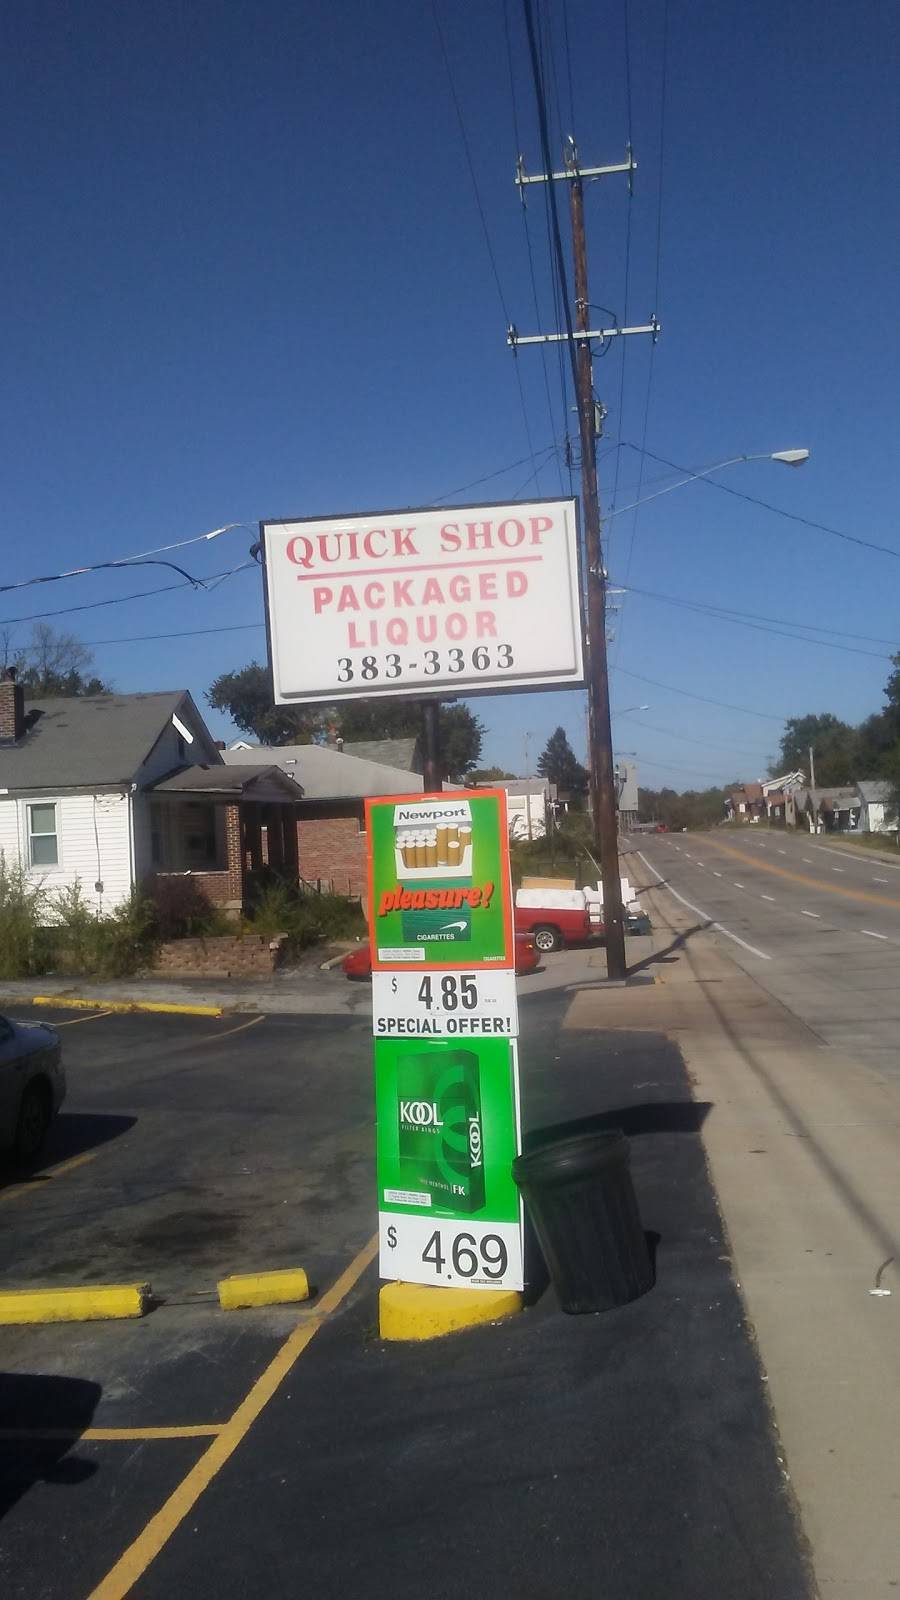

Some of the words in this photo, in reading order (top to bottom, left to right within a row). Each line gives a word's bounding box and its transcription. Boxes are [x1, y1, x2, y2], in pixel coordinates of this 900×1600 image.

[286, 527, 420, 569] QUICK
[440, 516, 554, 553] SHOP
[313, 570, 529, 614] PACKAGED
[347, 611, 498, 648] LIQUOR
[337, 644, 515, 682] 383-3363
[398, 807, 467, 821] Newport
[377, 881, 494, 918] pleasure!
[416, 933, 455, 941] CIGARETTES
[391, 977, 398, 994] $
[418, 974, 478, 1011] 4.85
[377, 1018, 441, 1034] SPECIAL
[446, 1017, 511, 1033] OFFER!
[400, 1101, 443, 1126] KOOL
[469, 1111, 482, 1168] KOOL
[452, 1184, 465, 1196] FK
[387, 1224, 398, 1251] $
[421, 1230, 508, 1280] 4.69
